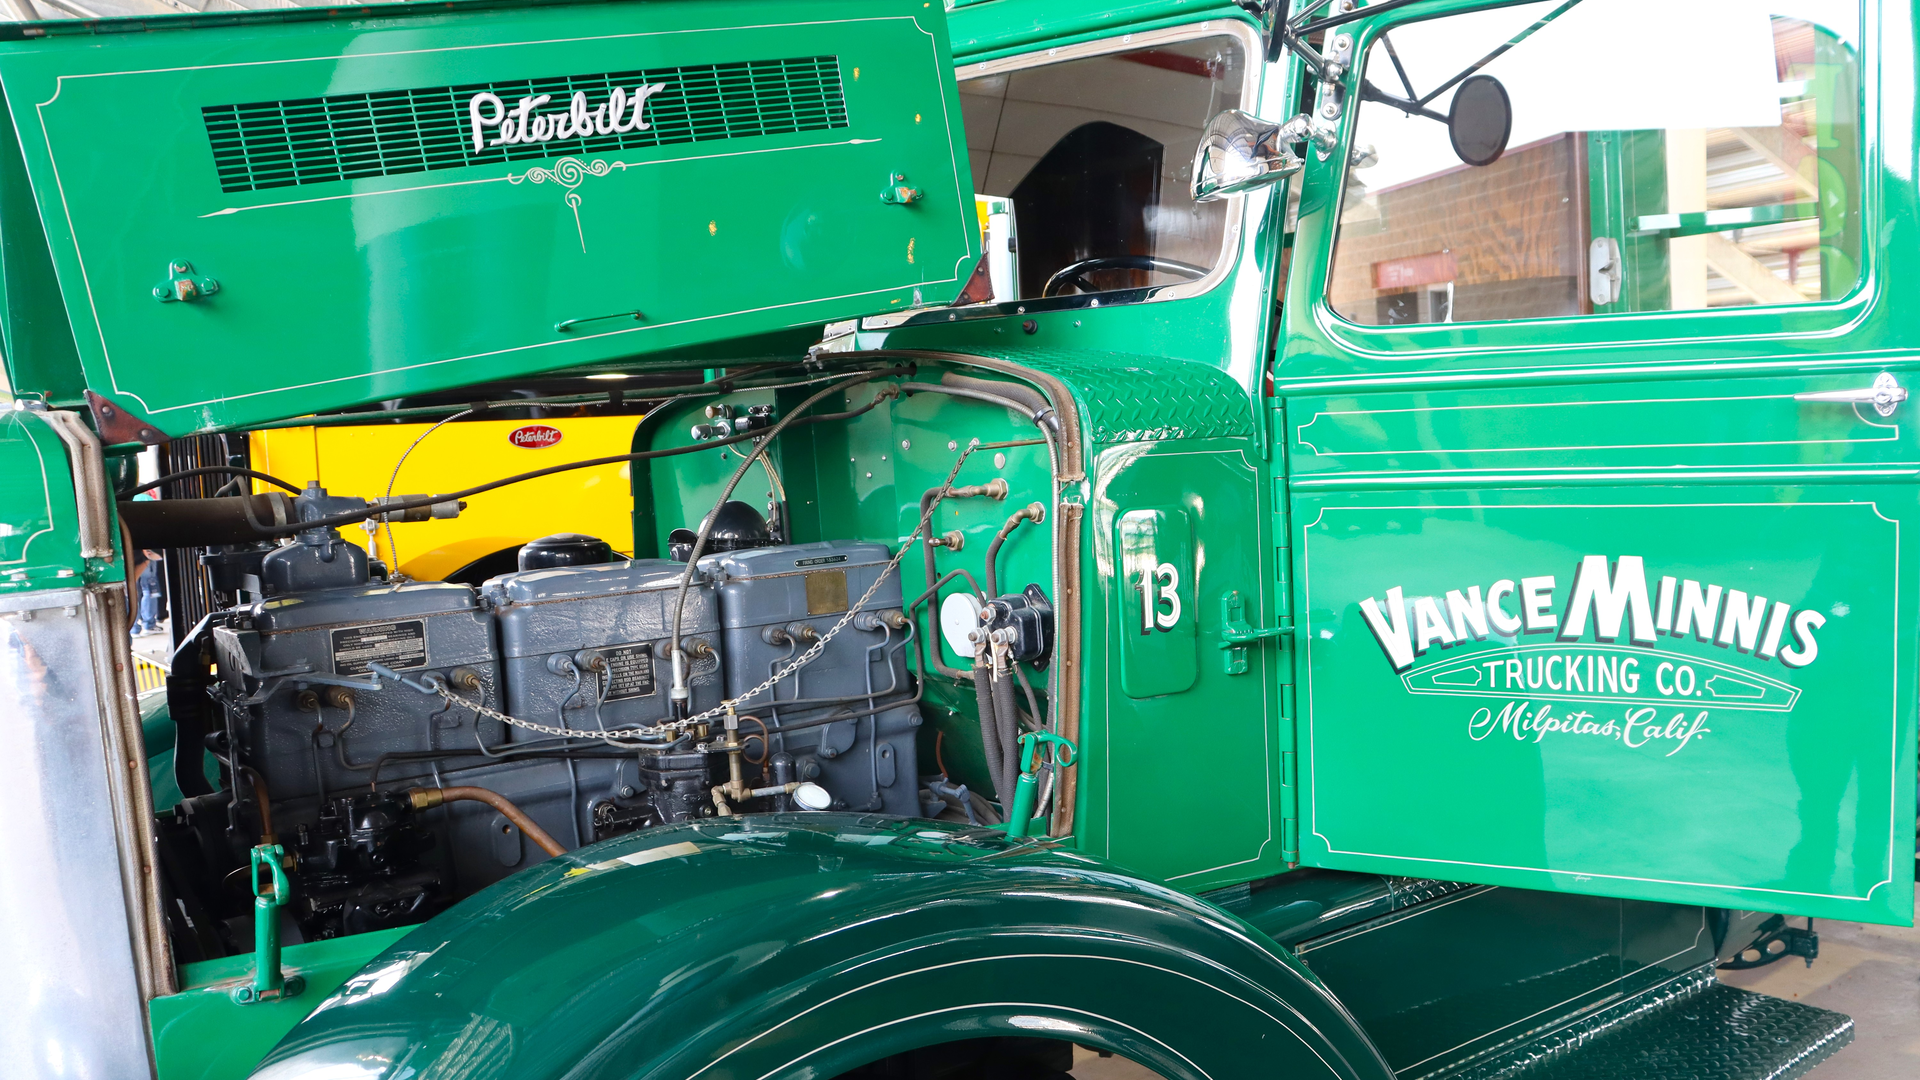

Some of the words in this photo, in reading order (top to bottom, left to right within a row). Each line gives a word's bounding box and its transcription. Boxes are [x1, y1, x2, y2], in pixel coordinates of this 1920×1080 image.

[470, 83, 666, 154] Peterbilt
[515, 430, 558, 444] Peterbilt
[1135, 562, 1181, 636] 13
[1359, 575, 1559, 676] VANCE
[1555, 555, 1827, 670] MINNIS
[359, 625, 396, 634] WARNING
[1482, 655, 1640, 693] TRUCKING
[1655, 661, 1702, 697] CO.
[1468, 701, 1622, 744] Milpitas,
[1623, 707, 1711, 757] Calif.
